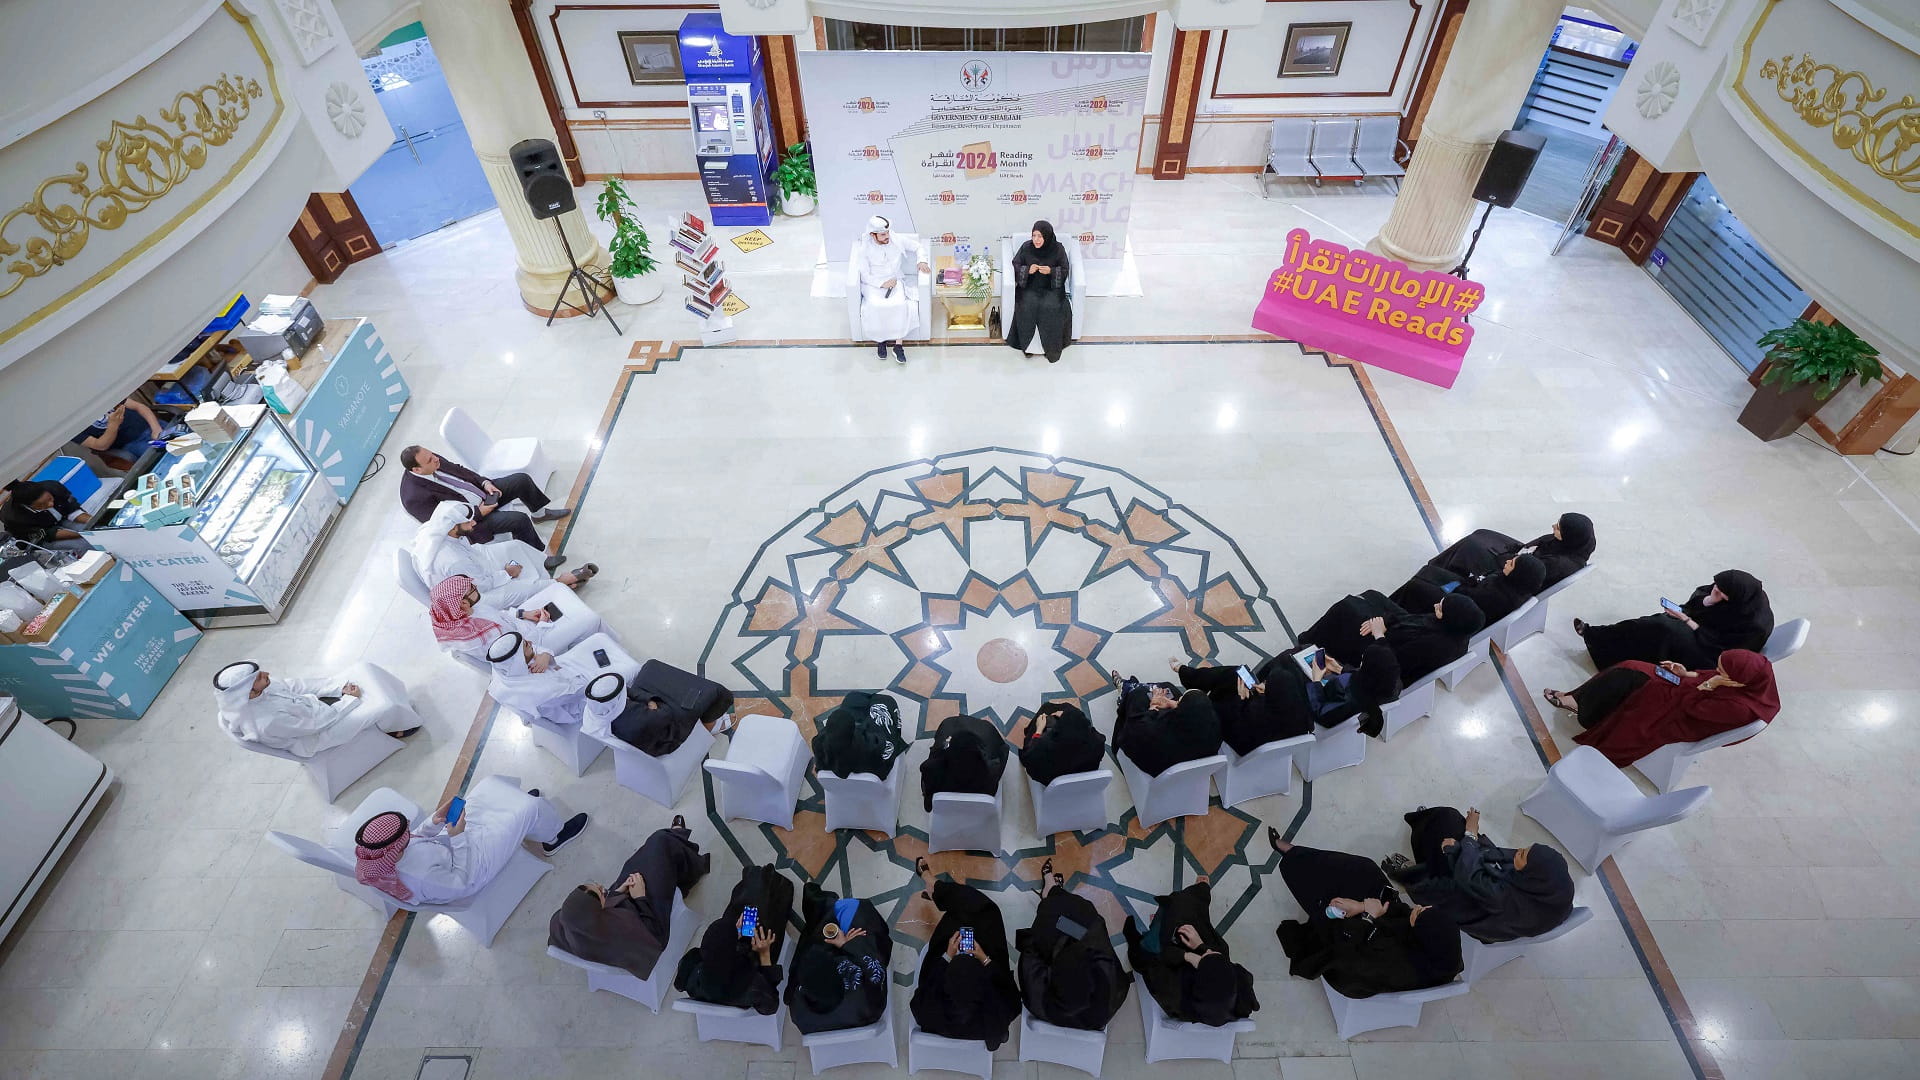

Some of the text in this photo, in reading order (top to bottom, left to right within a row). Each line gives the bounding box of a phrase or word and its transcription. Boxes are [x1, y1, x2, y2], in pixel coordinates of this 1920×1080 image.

[858, 101, 875, 109] 2024
[1090, 100, 1107, 108] 2024
[862, 149, 880, 157] 2024
[929, 149, 954, 159] شهر
[1000, 152, 1033, 160] Reading
[1085, 148, 1103, 157] 2024
[921, 159, 955, 168] القراءة
[956, 152, 998, 169] 2024
[1000, 160, 1028, 168] Month
[1030, 171, 1136, 193] MARCH
[867, 193, 884, 201] 2024
[1082, 193, 1099, 201] 2024
[1289, 234, 1480, 313] #الإمارات تقرأ
[1272, 270, 1465, 346] #UAE Reads
[338, 382, 371, 429] YAMANOTE
[131, 559, 154, 569] WE
[156, 555, 209, 567] CATER!
[177, 584, 215, 592] JAPANESE
[92, 640, 116, 664] WE
[114, 595, 152, 640] CATER!
[140, 638, 166, 670] JAPANESE
[133, 653, 146, 666] THE
[143, 649, 165, 674] BAKERS
